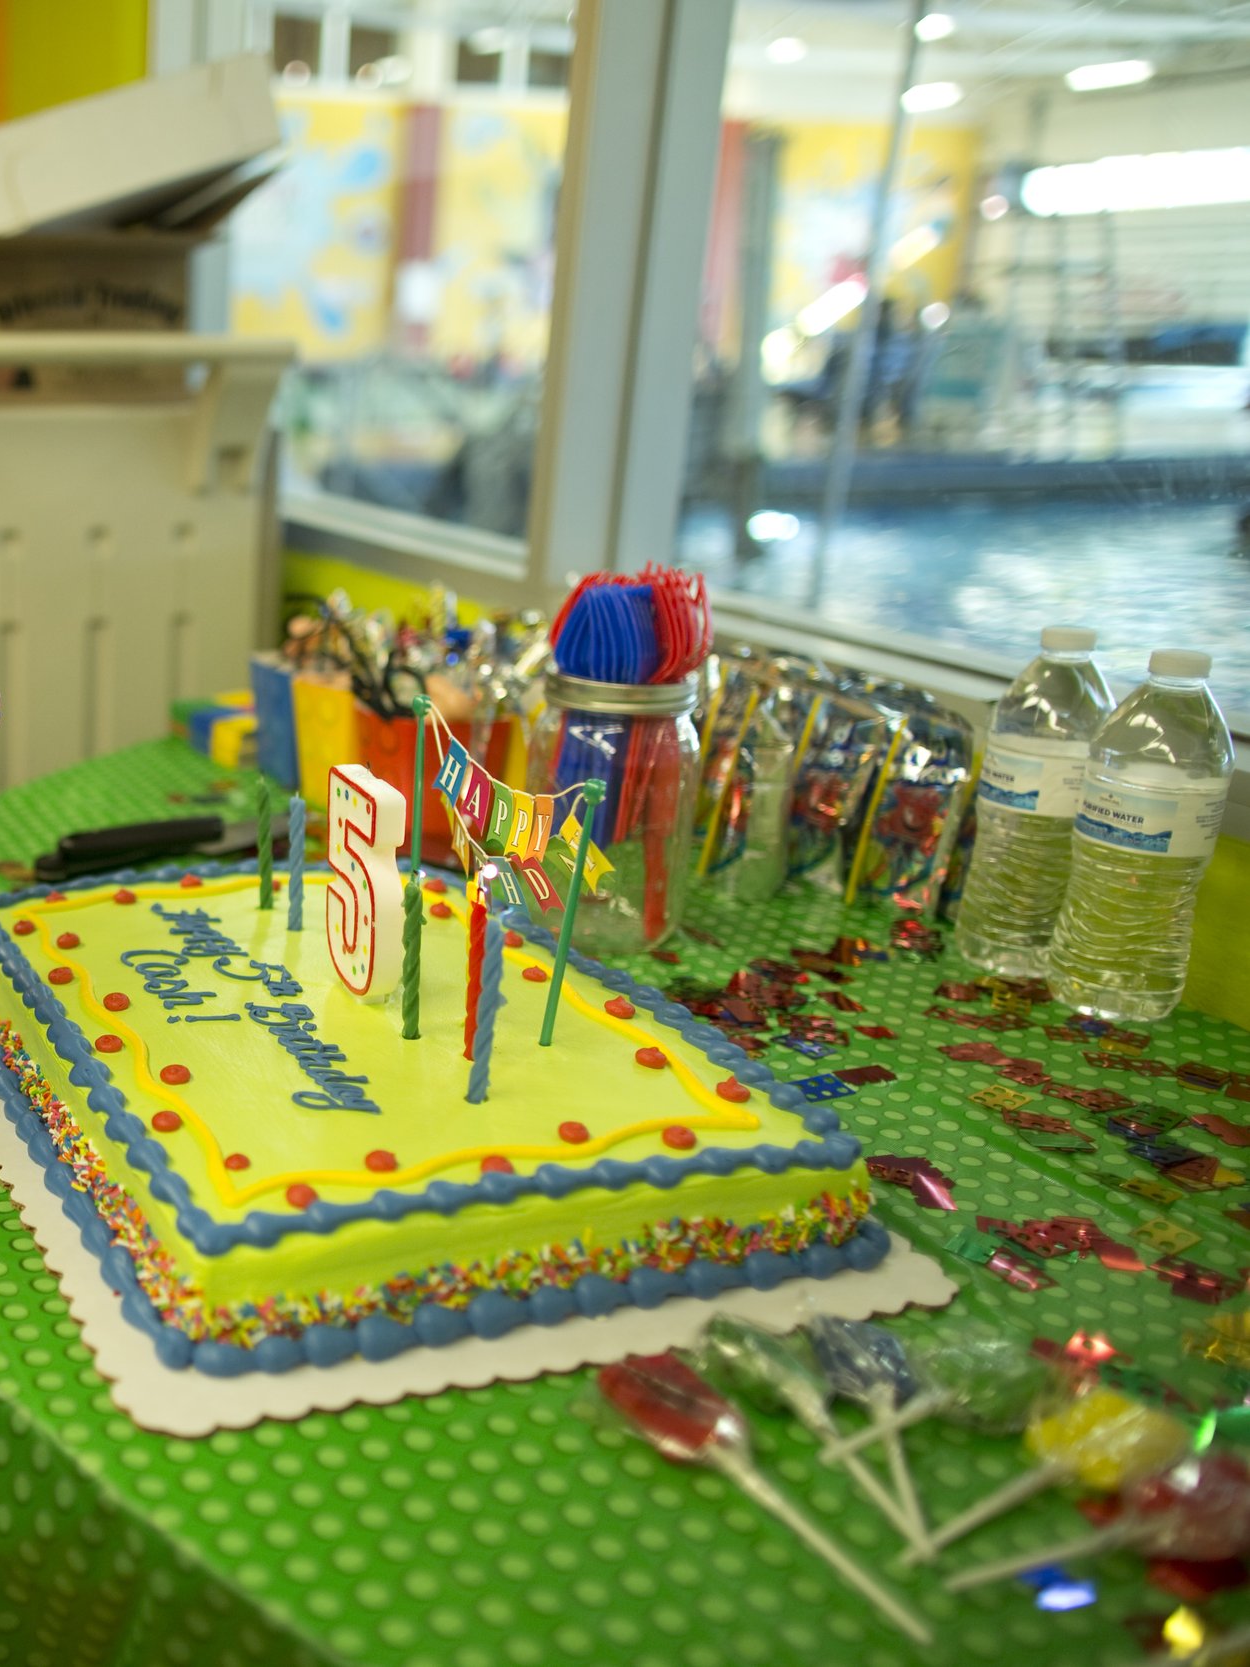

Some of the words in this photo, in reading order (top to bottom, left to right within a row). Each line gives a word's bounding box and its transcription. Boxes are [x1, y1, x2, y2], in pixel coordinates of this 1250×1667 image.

[439, 752, 551, 852] HAPPY
[1112, 811, 1145, 824] WATER
[325, 764, 390, 996] 5
[244, 1002, 382, 1115] Birthday
